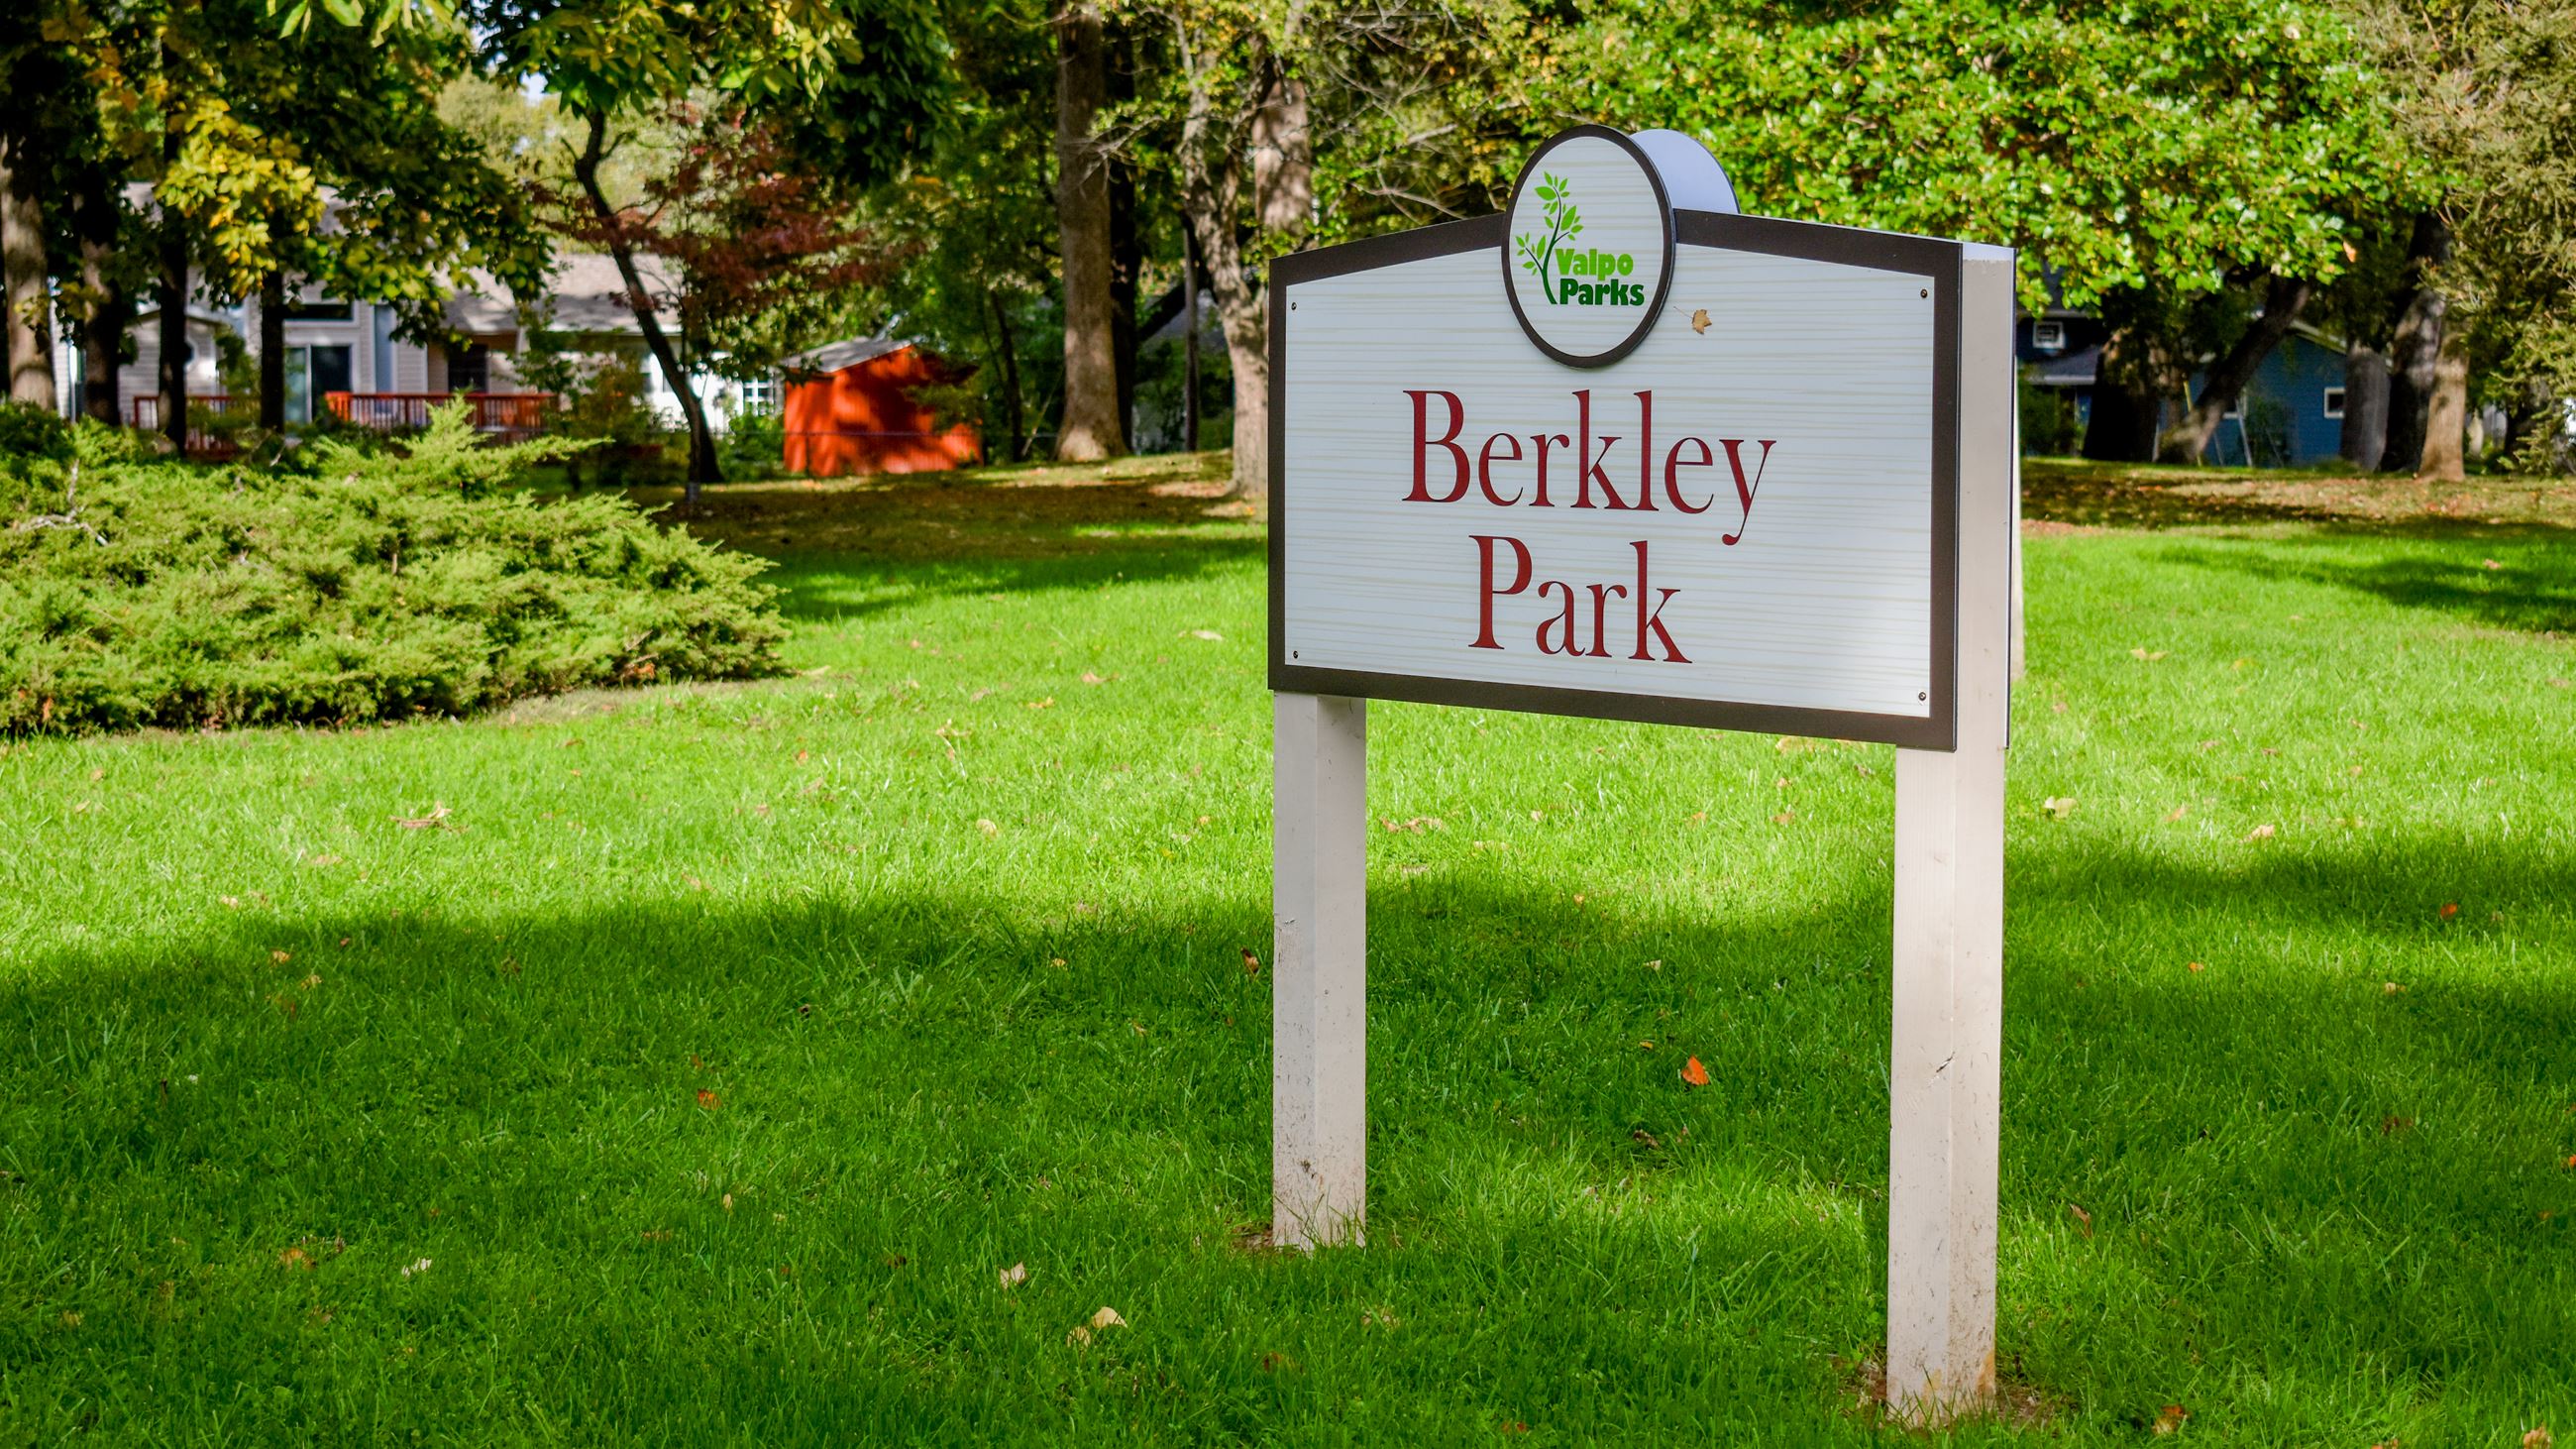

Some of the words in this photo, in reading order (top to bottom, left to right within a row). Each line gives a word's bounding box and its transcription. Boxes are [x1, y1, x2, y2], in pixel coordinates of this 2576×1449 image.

[1555, 248, 1634, 281] Valpo
[1559, 278, 1645, 306] Parks
[1401, 389, 1777, 546] Berkley
[1468, 534, 1694, 665] Park
